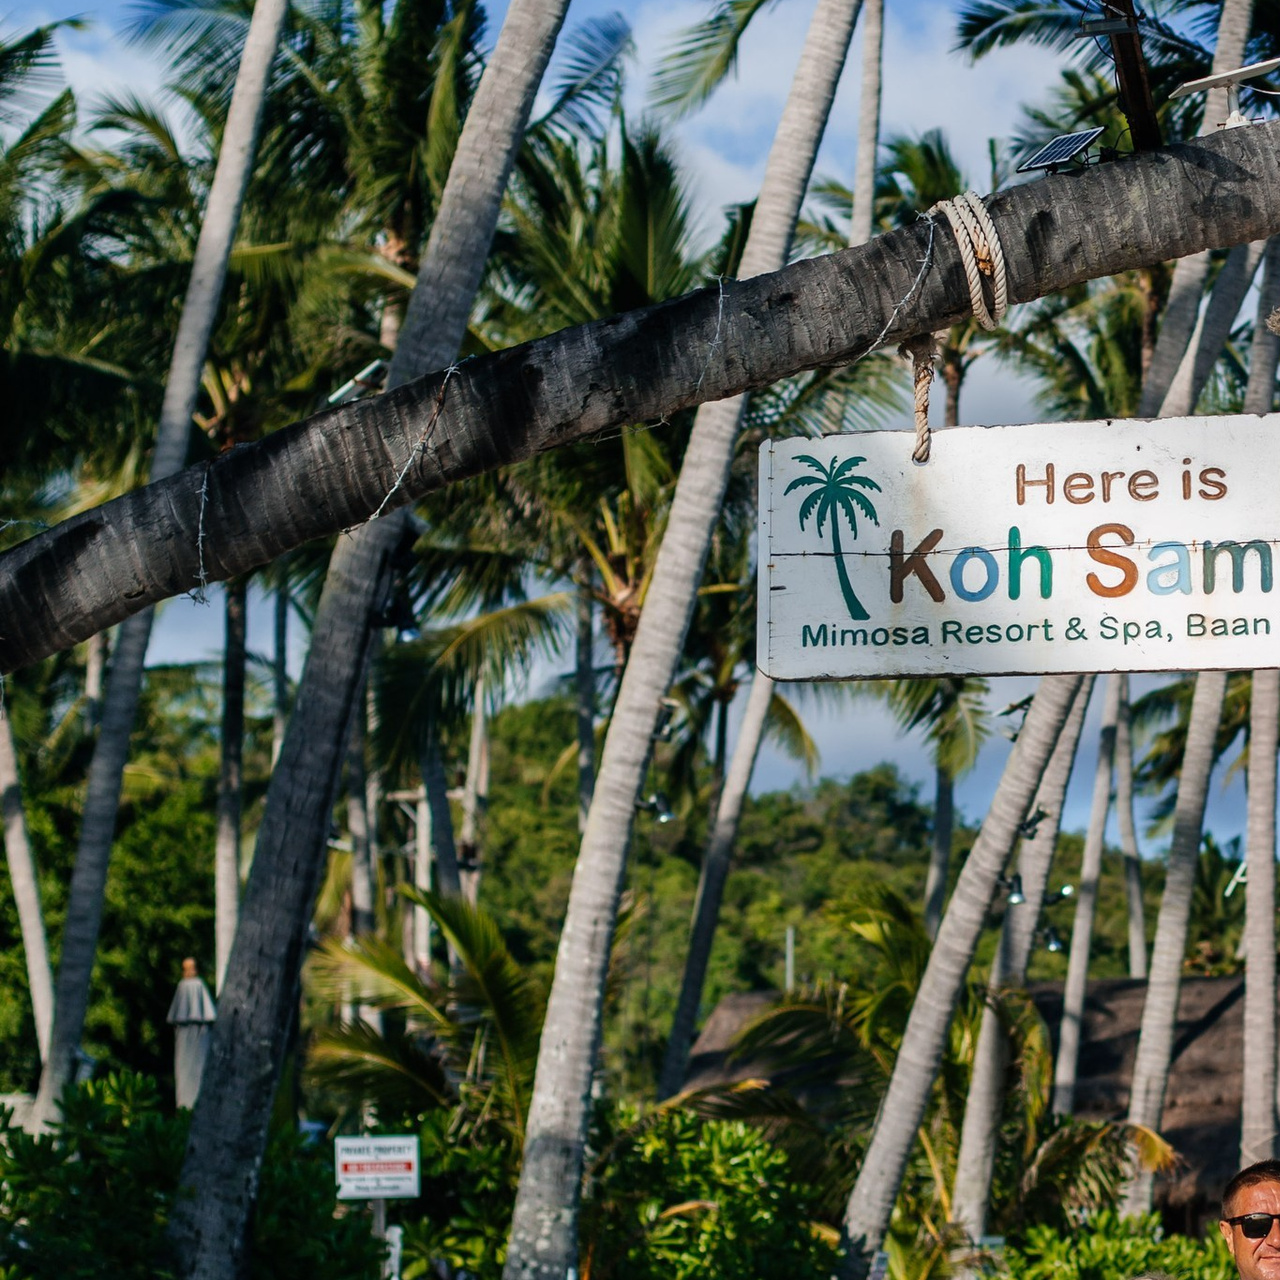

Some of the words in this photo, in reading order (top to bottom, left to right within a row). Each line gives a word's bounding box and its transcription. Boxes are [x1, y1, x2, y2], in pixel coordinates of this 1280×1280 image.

[1016, 462, 1159, 506] Here
[1182, 457, 1228, 501] is
[889, 525, 1053, 604] Koh
[801, 622, 930, 648] Mimosa
[941, 618, 1055, 644] Resort
[1064, 616, 1089, 641] &
[1099, 615, 1174, 645] Spa,
[1186, 612, 1271, 637] Baan
